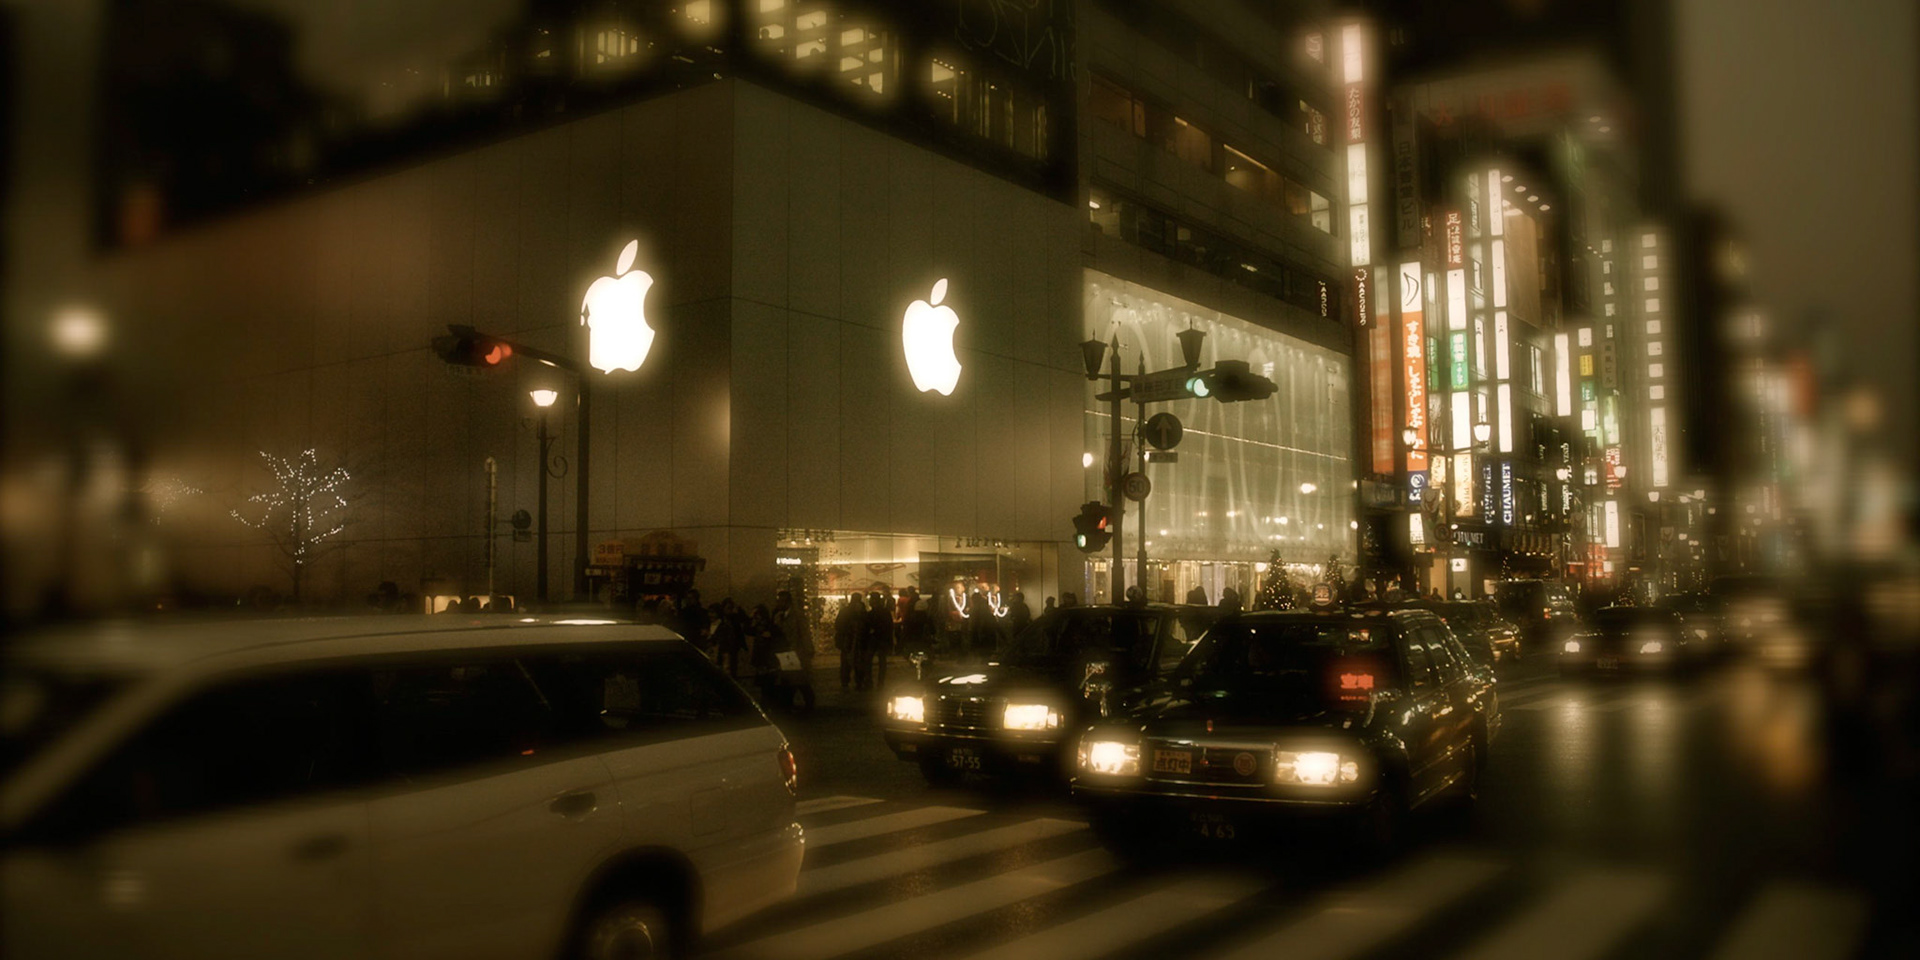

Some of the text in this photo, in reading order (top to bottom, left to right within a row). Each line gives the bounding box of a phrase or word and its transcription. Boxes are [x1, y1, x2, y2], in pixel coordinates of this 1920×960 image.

[1348, 87, 1361, 140] たかの友梨
[1129, 482, 1145, 493] 50
[1502, 463, 1511, 524] CHAUMET
[952, 754, 981, 769] 57-55
[1155, 756, 1190, 773] 点灯中
